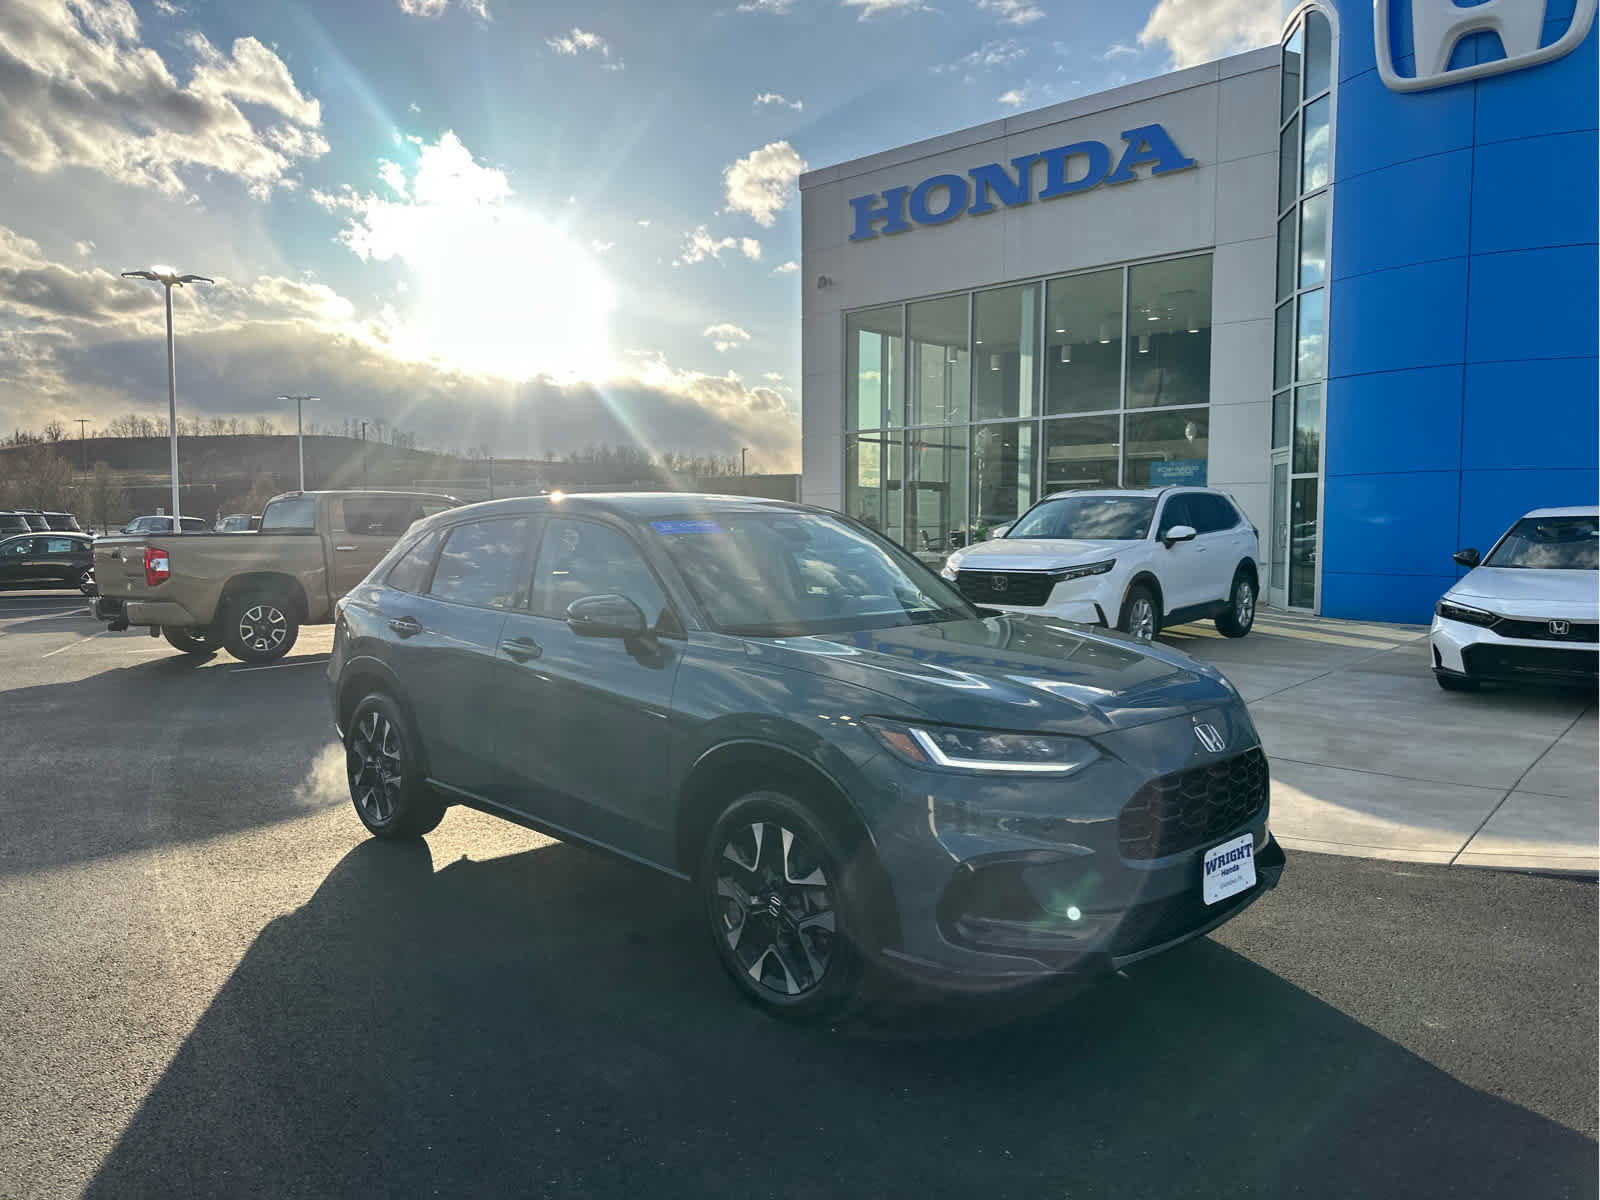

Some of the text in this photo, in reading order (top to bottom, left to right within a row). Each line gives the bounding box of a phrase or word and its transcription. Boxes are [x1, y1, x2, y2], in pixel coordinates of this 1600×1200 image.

[848, 123, 1196, 242] HONDA
[1206, 843, 1252, 876] WRIGHT
[1221, 864, 1239, 876] Honda
